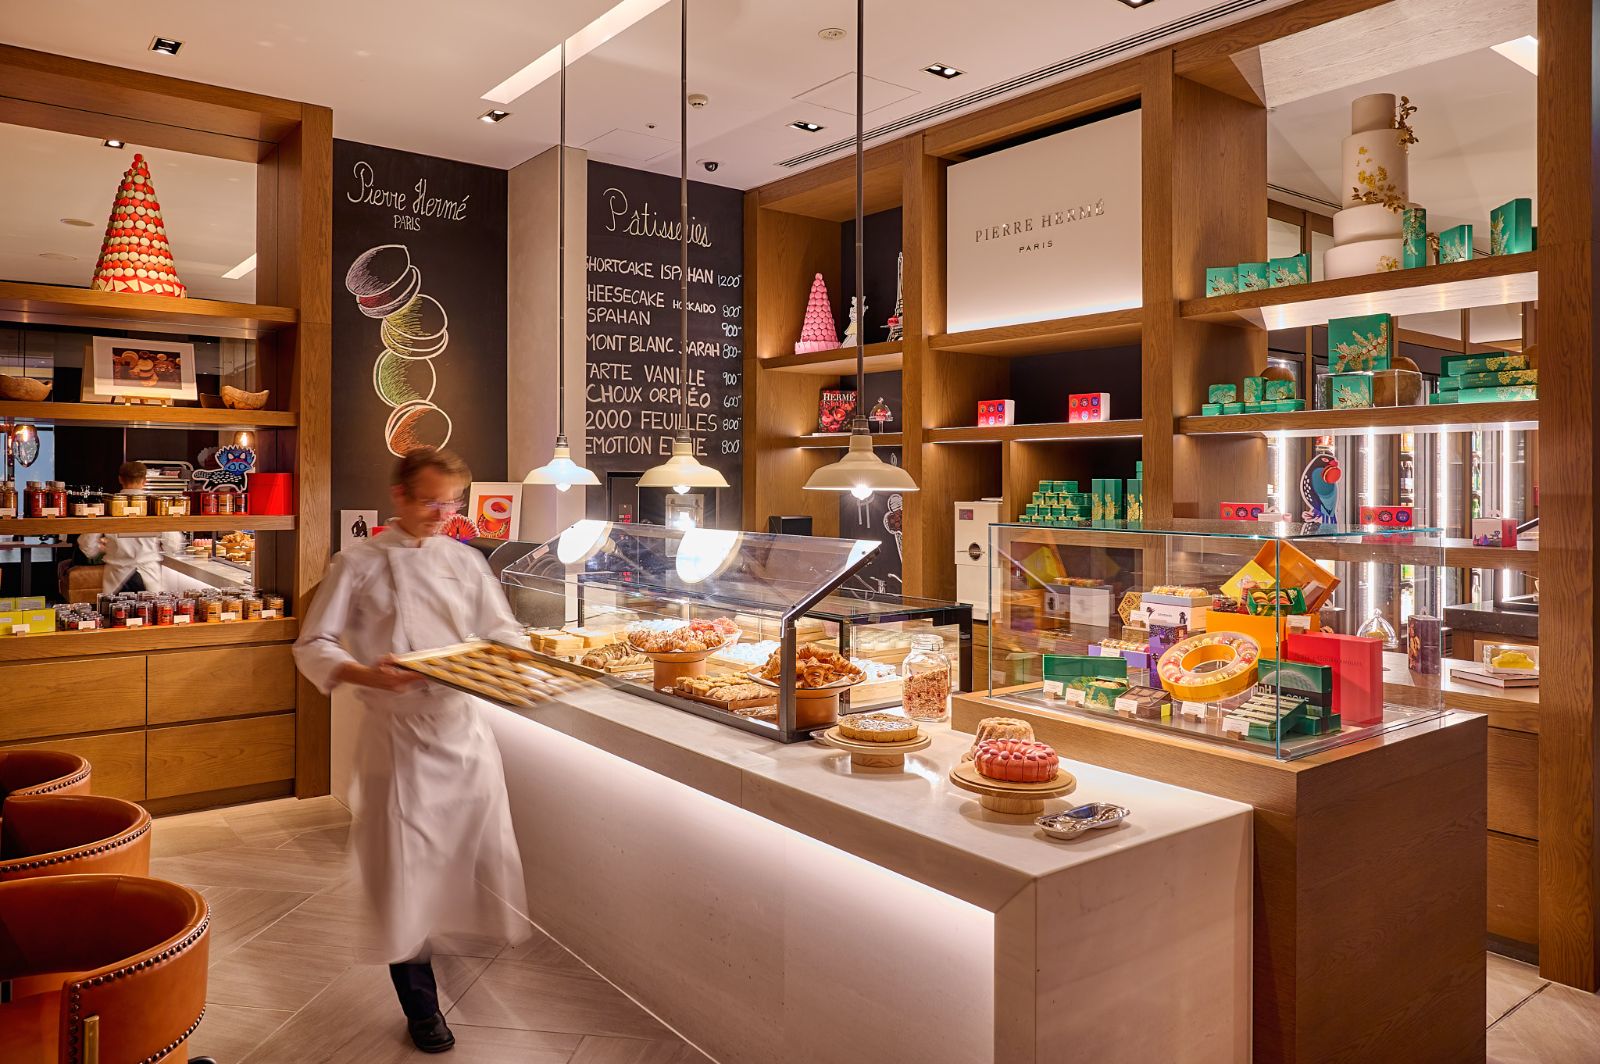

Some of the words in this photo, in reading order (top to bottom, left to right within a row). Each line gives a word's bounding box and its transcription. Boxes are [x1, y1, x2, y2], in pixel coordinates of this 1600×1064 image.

[347, 161, 406, 211] Pierre
[413, 178, 470, 221] Hermé
[394, 214, 421, 231] PARIS
[603, 188, 711, 248] Pâtisseies
[975, 218, 1034, 243] PIERRE
[1041, 198, 1105, 228] HERMÉ
[1018, 240, 1053, 253] PARIS
[587, 284, 665, 308] HEESECAKE
[587, 307, 651, 326] SPAHAN
[629, 335, 674, 353] BLANC
[586, 384, 643, 404] CHOUX
[823, 393, 856, 402] HERMÉ
[586, 410, 632, 430] 2000
